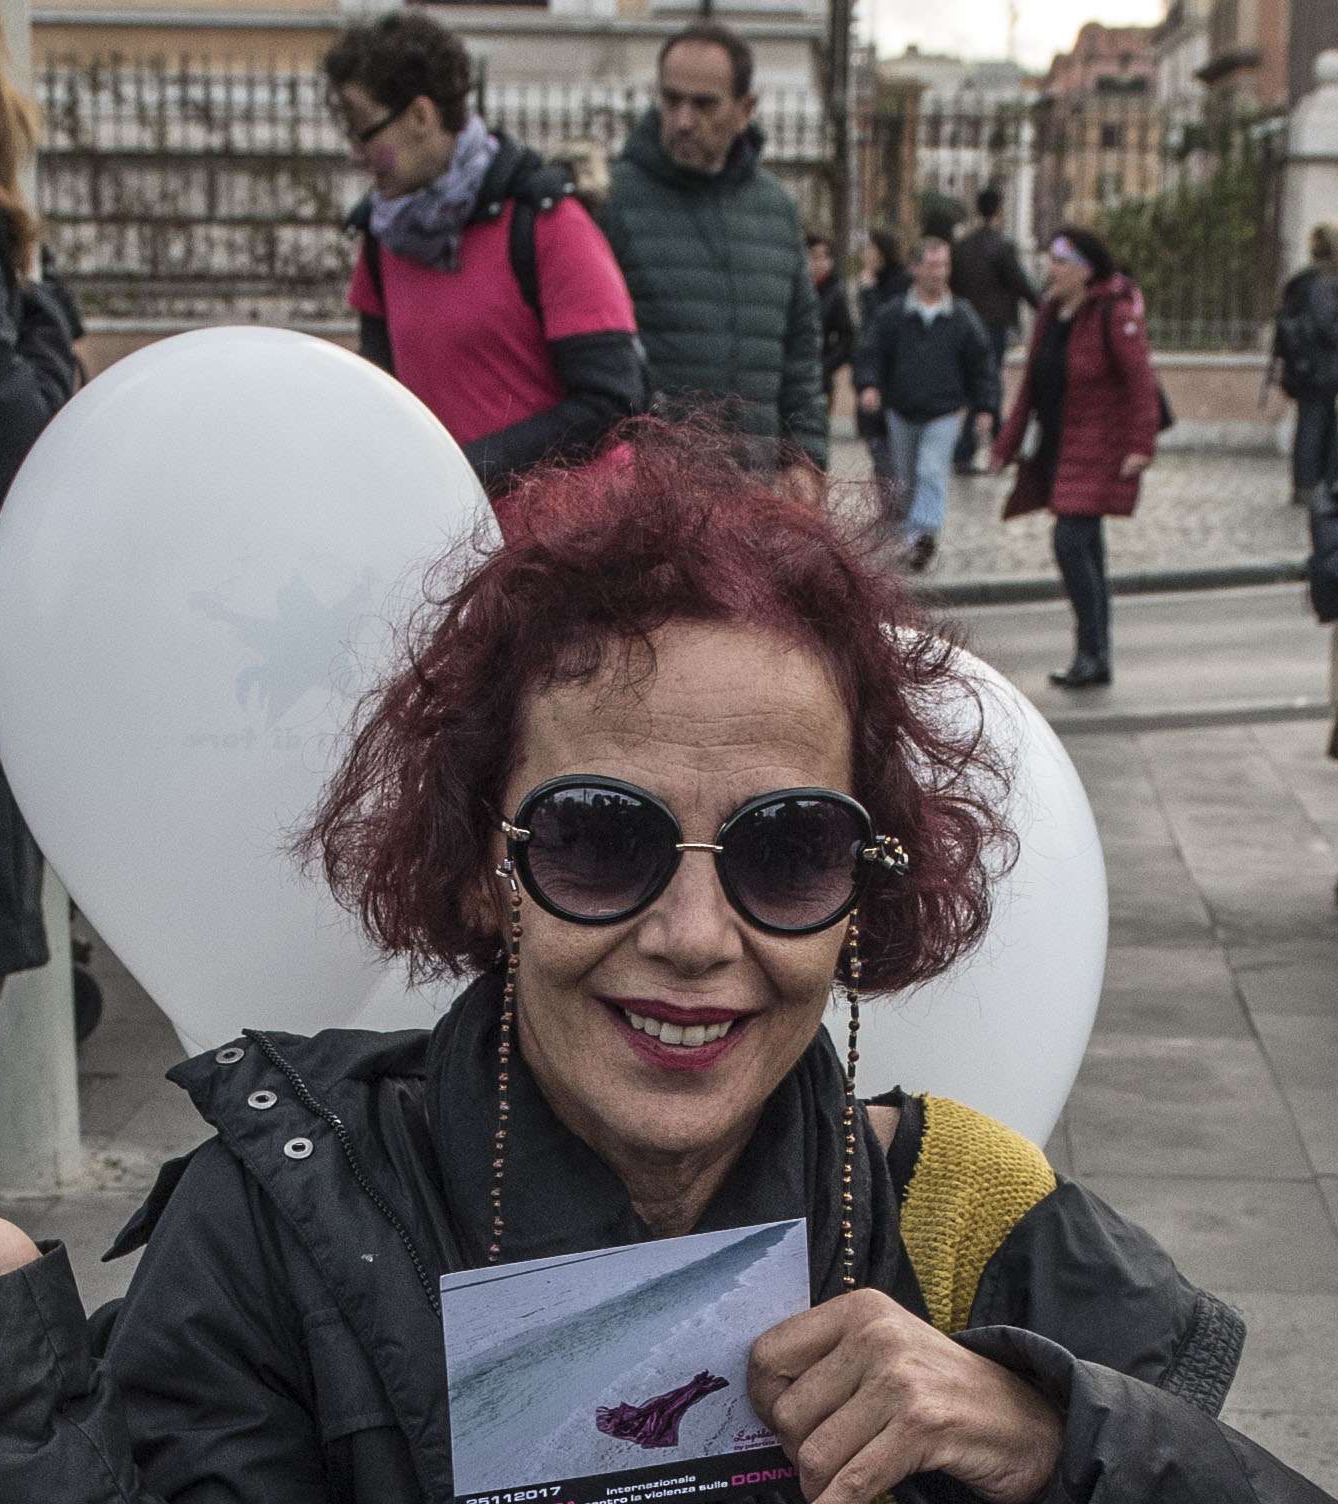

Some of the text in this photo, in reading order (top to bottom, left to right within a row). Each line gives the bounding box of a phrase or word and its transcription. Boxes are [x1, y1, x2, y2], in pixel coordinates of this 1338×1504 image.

[630, 1494, 642, 1502] la
[644, 1486, 696, 1500] violenza
[698, 1480, 729, 1491] sulle
